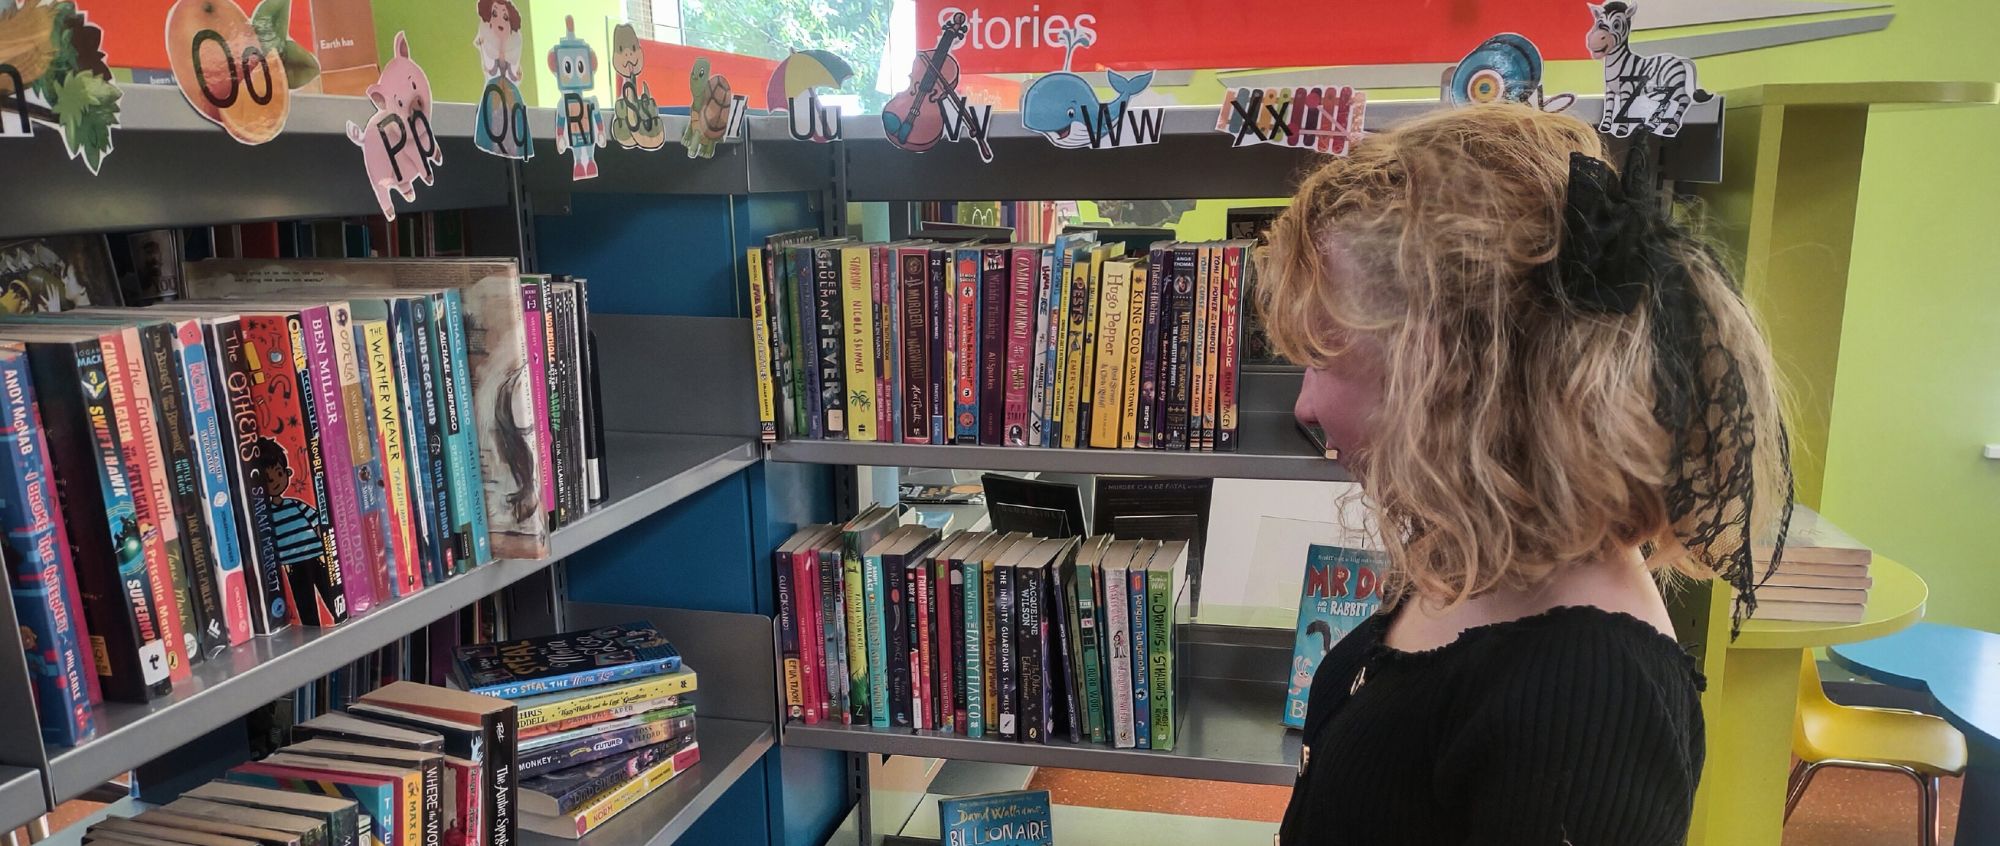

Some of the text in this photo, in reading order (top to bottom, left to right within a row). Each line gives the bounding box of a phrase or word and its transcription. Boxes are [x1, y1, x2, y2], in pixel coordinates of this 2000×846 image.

[320, 38, 354, 49] Earth has
[937, 4, 1098, 51] Stories
[192, 29, 272, 108] Oo
[565, 92, 595, 146] Rr
[622, 80, 653, 134] Ss
[788, 97, 841, 140] Uu
[938, 97, 992, 140] Vv
[1081, 97, 1163, 149] Ww
[1230, 99, 1294, 145] Xx
[1614, 76, 1676, 123] Zz
[377, 111, 436, 182] Pp
[484, 85, 529, 162] Qq
[815, 250, 829, 318] SHULMAN
[828, 270, 837, 296] DEE
[1150, 263, 1160, 290] Maisie
[1211, 286, 1219, 311] POWER
[985, 273, 998, 339] Wishful Thinking
[1039, 297, 1048, 316] ICE
[1071, 280, 1085, 321] PESTS
[1102, 273, 1122, 355] Hugo Pepper
[1129, 290, 1143, 354] KING COO
[1148, 293, 1158, 325] Hitchins
[311, 319, 328, 354] BEN
[369, 328, 384, 336] THE
[546, 311, 557, 364] WORMHOLE
[852, 300, 865, 374] NICOLA SKINNER
[1170, 335, 1178, 362] MANIFESTOR
[1178, 311, 1190, 343] NIC BLAKE
[1195, 318, 1204, 366] GROOTSLANG
[1208, 322, 1216, 353] YUMBOES
[1225, 304, 1238, 368] MURDER
[89, 371, 98, 385] 3
[339, 329, 356, 383] ODELIA
[417, 326, 437, 426] UNDERGROUND
[450, 301, 471, 426] MICHAEL MORPURGO
[822, 320, 843, 402] FEVER
[986, 351, 996, 389] Ali Sparkes
[1069, 359, 1077, 381] EMER
[1128, 365, 1136, 385] ADAM
[225, 330, 261, 463] The OTHERS
[301, 369, 320, 438] ACCIDENTAL
[319, 358, 339, 426] MILLER
[372, 338, 400, 461] WEATHER WEAVER
[439, 330, 458, 432] MICHAEL MORPURGO
[1222, 371, 1233, 427] RHIAN TRACEY
[4, 369, 33, 455] ANDY McNAB
[89, 405, 129, 497] SWIFT HAWK
[129, 358, 142, 387] The
[152, 478, 172, 522] Truth
[310, 434, 326, 478] TROUBLE
[314, 477, 329, 525] MAGNET
[434, 459, 450, 540] Chris Morphew
[27, 481, 69, 634] BROKE THE INTERNET
[261, 533, 282, 594] MERRETT
[328, 527, 338, 559] ZANIB
[351, 534, 366, 574] DOG
[865, 558, 874, 590] WALLACE
[965, 566, 976, 620] Anna Wilson
[1306, 564, 1351, 600] MR
[146, 549, 173, 648] Priscilla Mante
[999, 588, 1008, 623] INFINITY
[1020, 589, 1030, 626] WILSON
[1028, 579, 1039, 635] JACQUELINE
[1329, 600, 1369, 617] RABBIT
[1133, 594, 1144, 684] Penguin Pandemonium
[1151, 604, 1166, 645] ORPHANS
[787, 659, 798, 678] EFUA
[892, 636, 902, 661] SPACE
[1000, 626, 1009, 672] GUARDIANS
[64, 650, 81, 701] PHIL EARLE
[504, 679, 568, 695] TO STEAL THE
[965, 628, 981, 717] FAMILY FIASCO
[1021, 656, 1032, 699] Edie Trimmer
[1031, 674, 1040, 695] Other
[1087, 664, 1099, 712] LAURA WOOD
[567, 705, 634, 724] CARNIVAL CAPER
[518, 755, 552, 772] MONKEY
[426, 766, 437, 809] WHERE
[494, 765, 508, 817] The Amber
[384, 797, 392, 844] THE
[408, 801, 417, 830] MAX
[594, 804, 614, 823] NORM
[949, 820, 1050, 846] BILLIONAIRE
